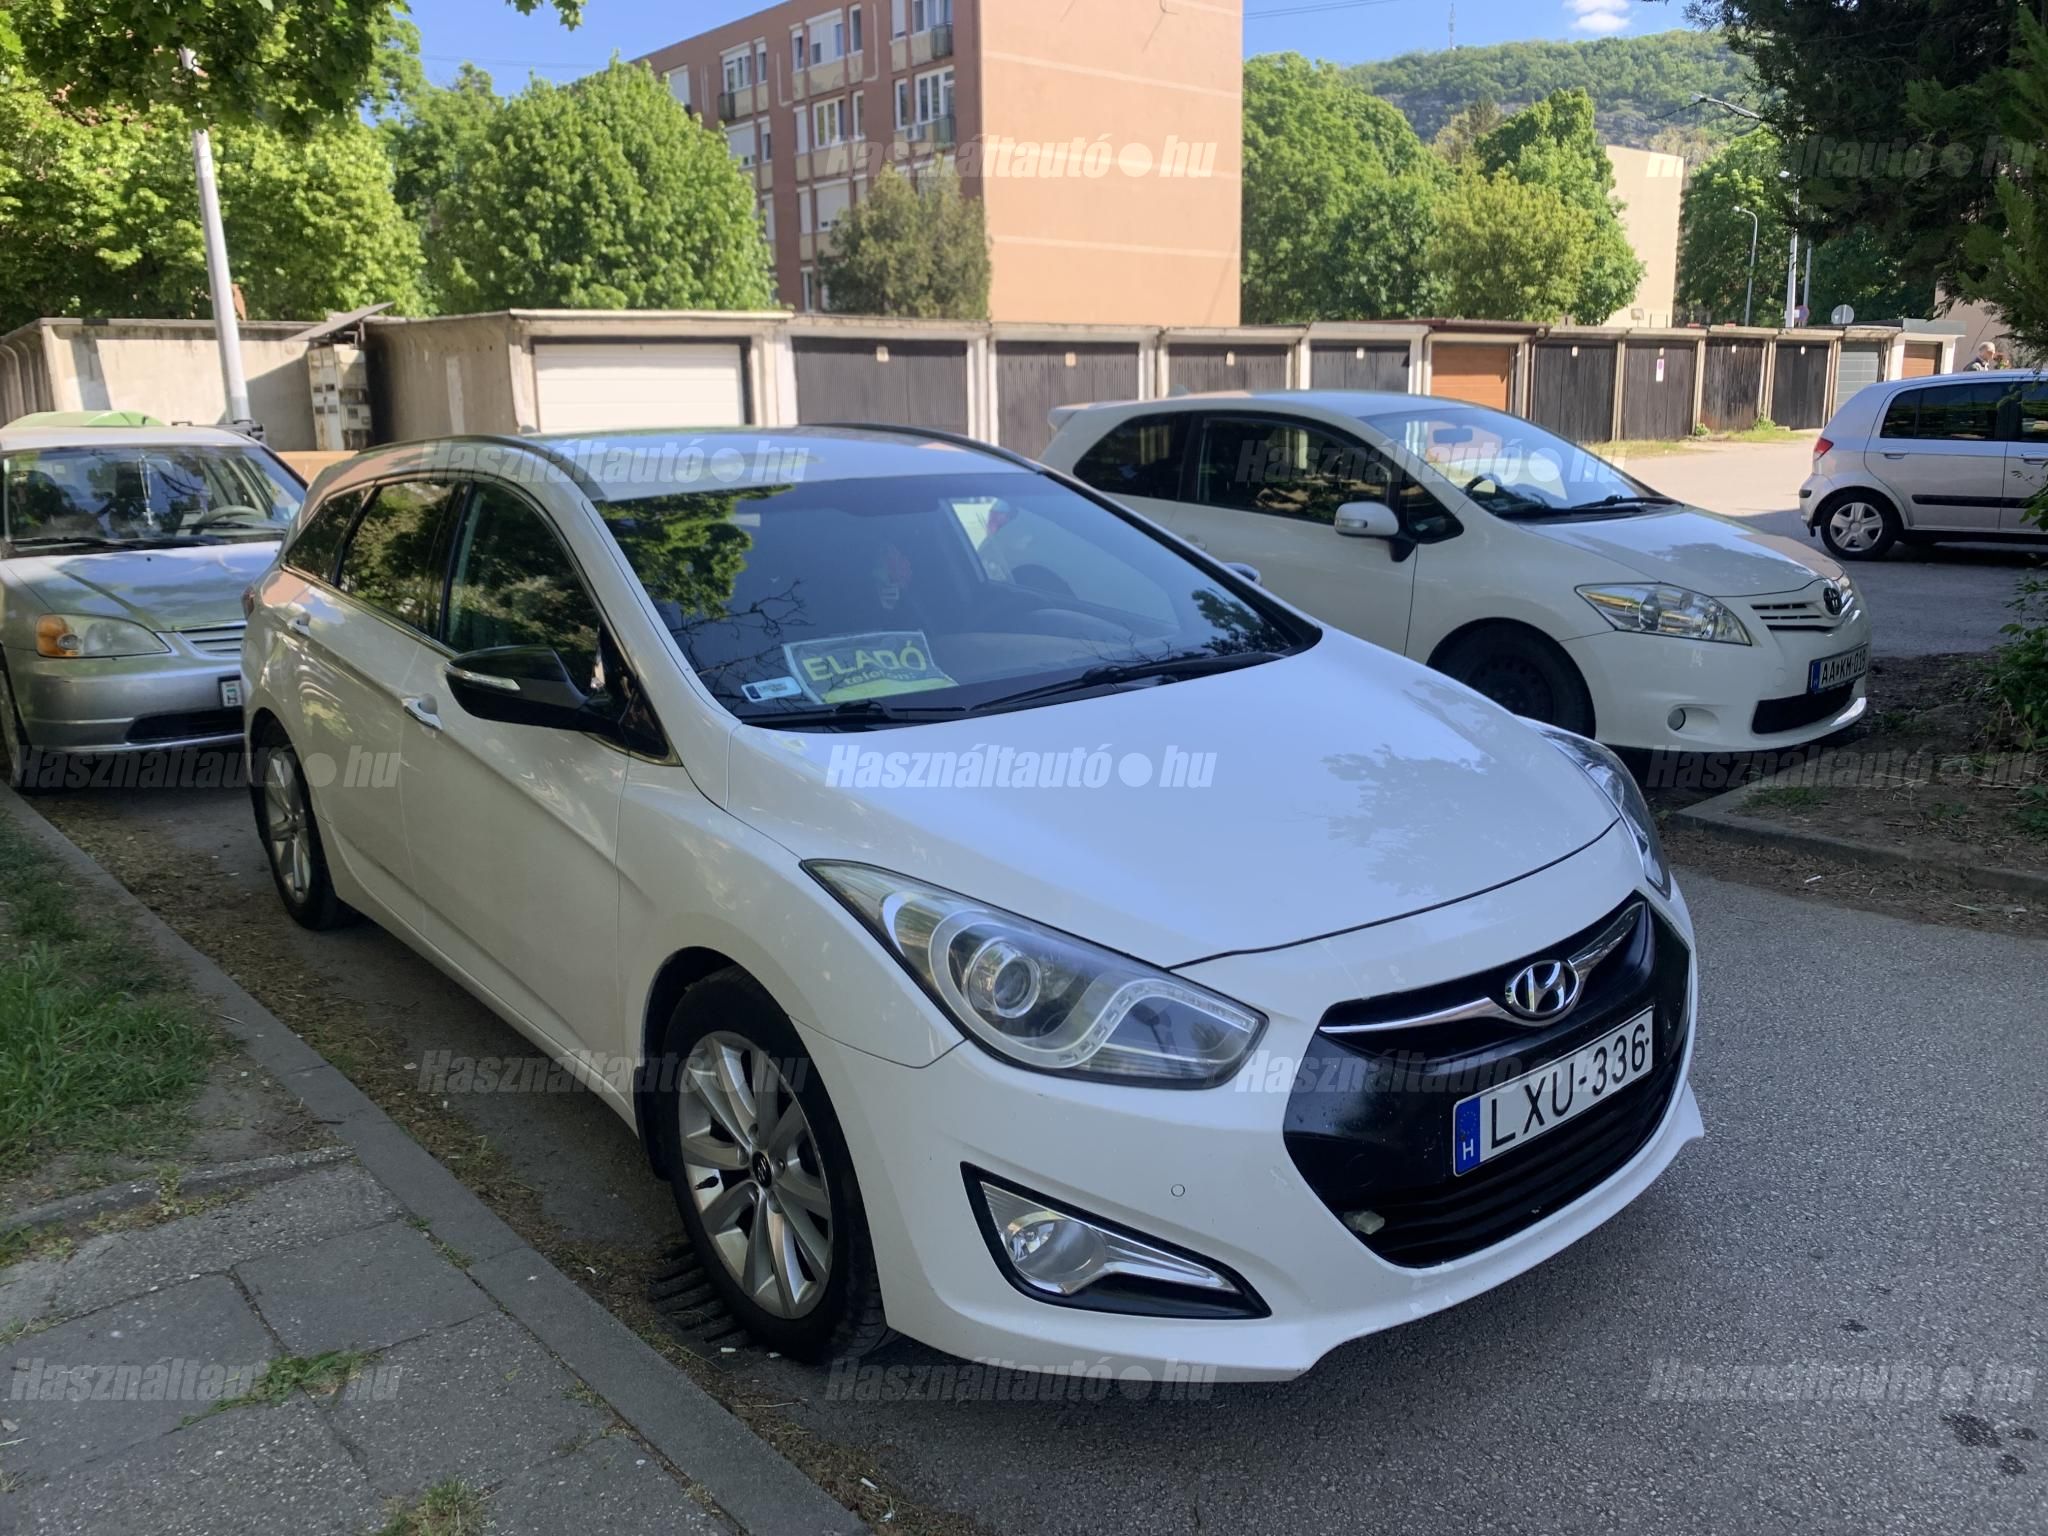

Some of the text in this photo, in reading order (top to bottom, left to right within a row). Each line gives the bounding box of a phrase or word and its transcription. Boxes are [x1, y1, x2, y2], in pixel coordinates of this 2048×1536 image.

[802, 640, 927, 681] ELADÓ
[1491, 1023, 1646, 1150] LXU-336
[1462, 1138, 1474, 1161] H
